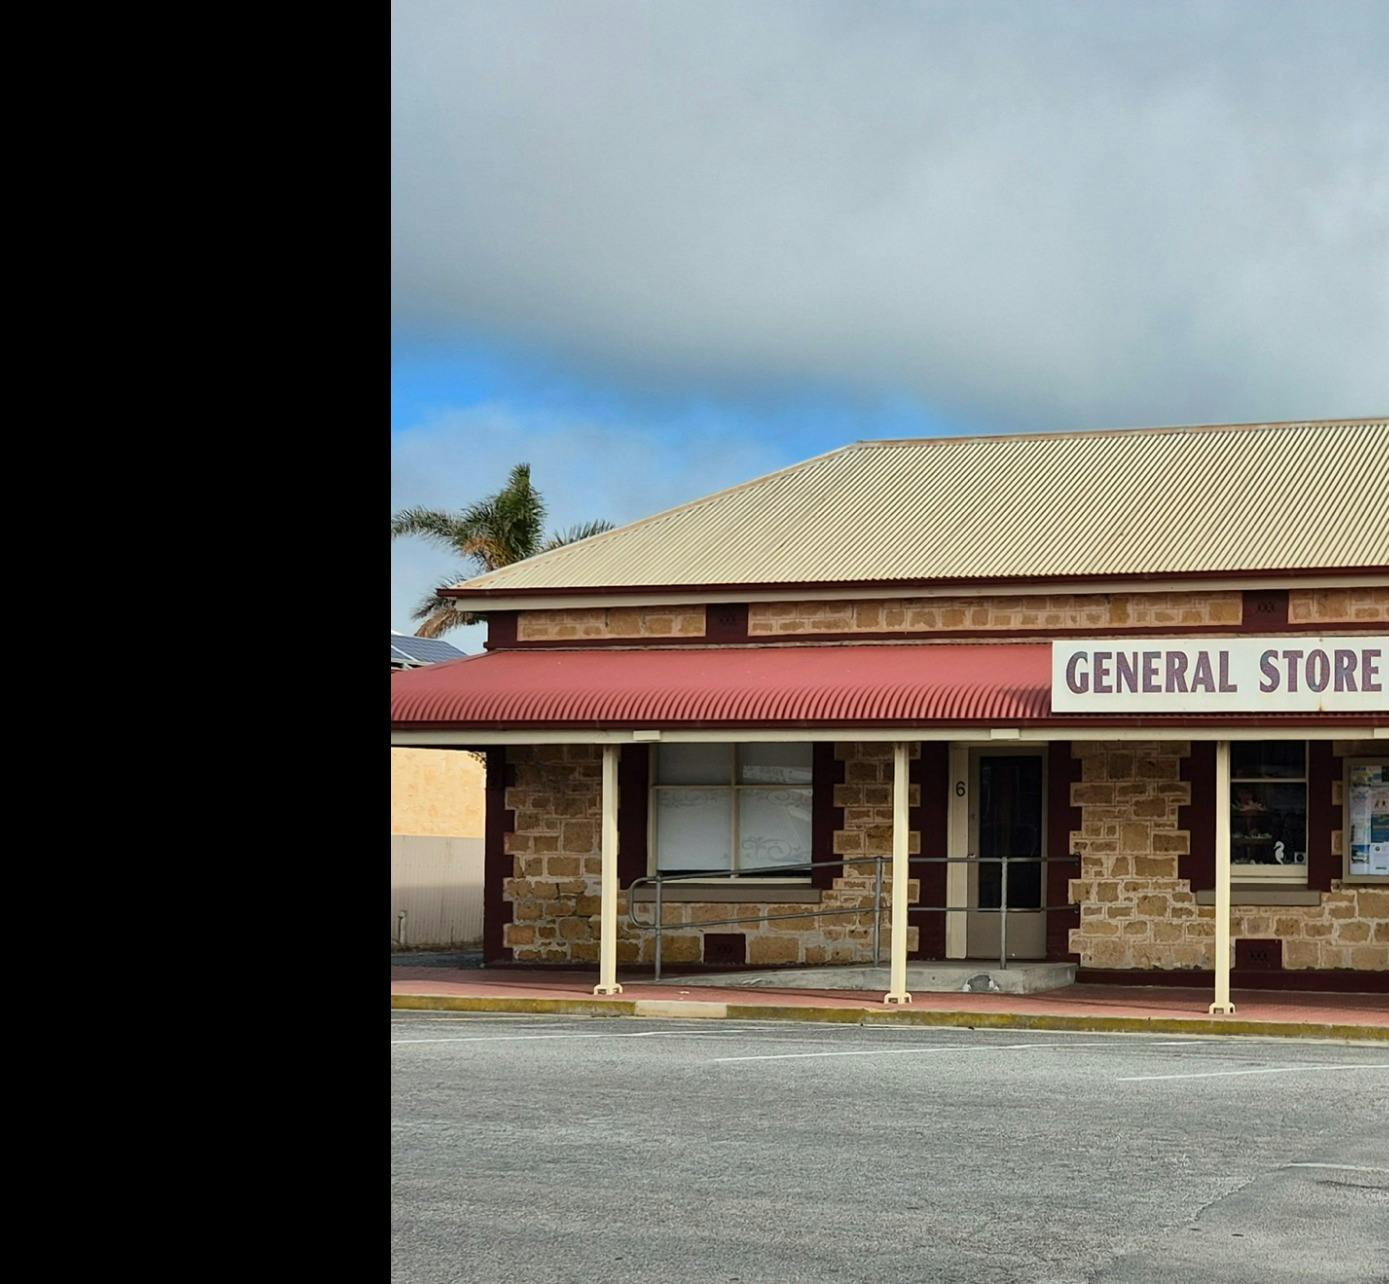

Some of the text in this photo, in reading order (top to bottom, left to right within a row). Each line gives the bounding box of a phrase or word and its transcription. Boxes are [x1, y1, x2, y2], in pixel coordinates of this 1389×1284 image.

[1065, 650, 1238, 694] GENERAL
[1259, 648, 1382, 693] STORE
[956, 781, 966, 797] 6
